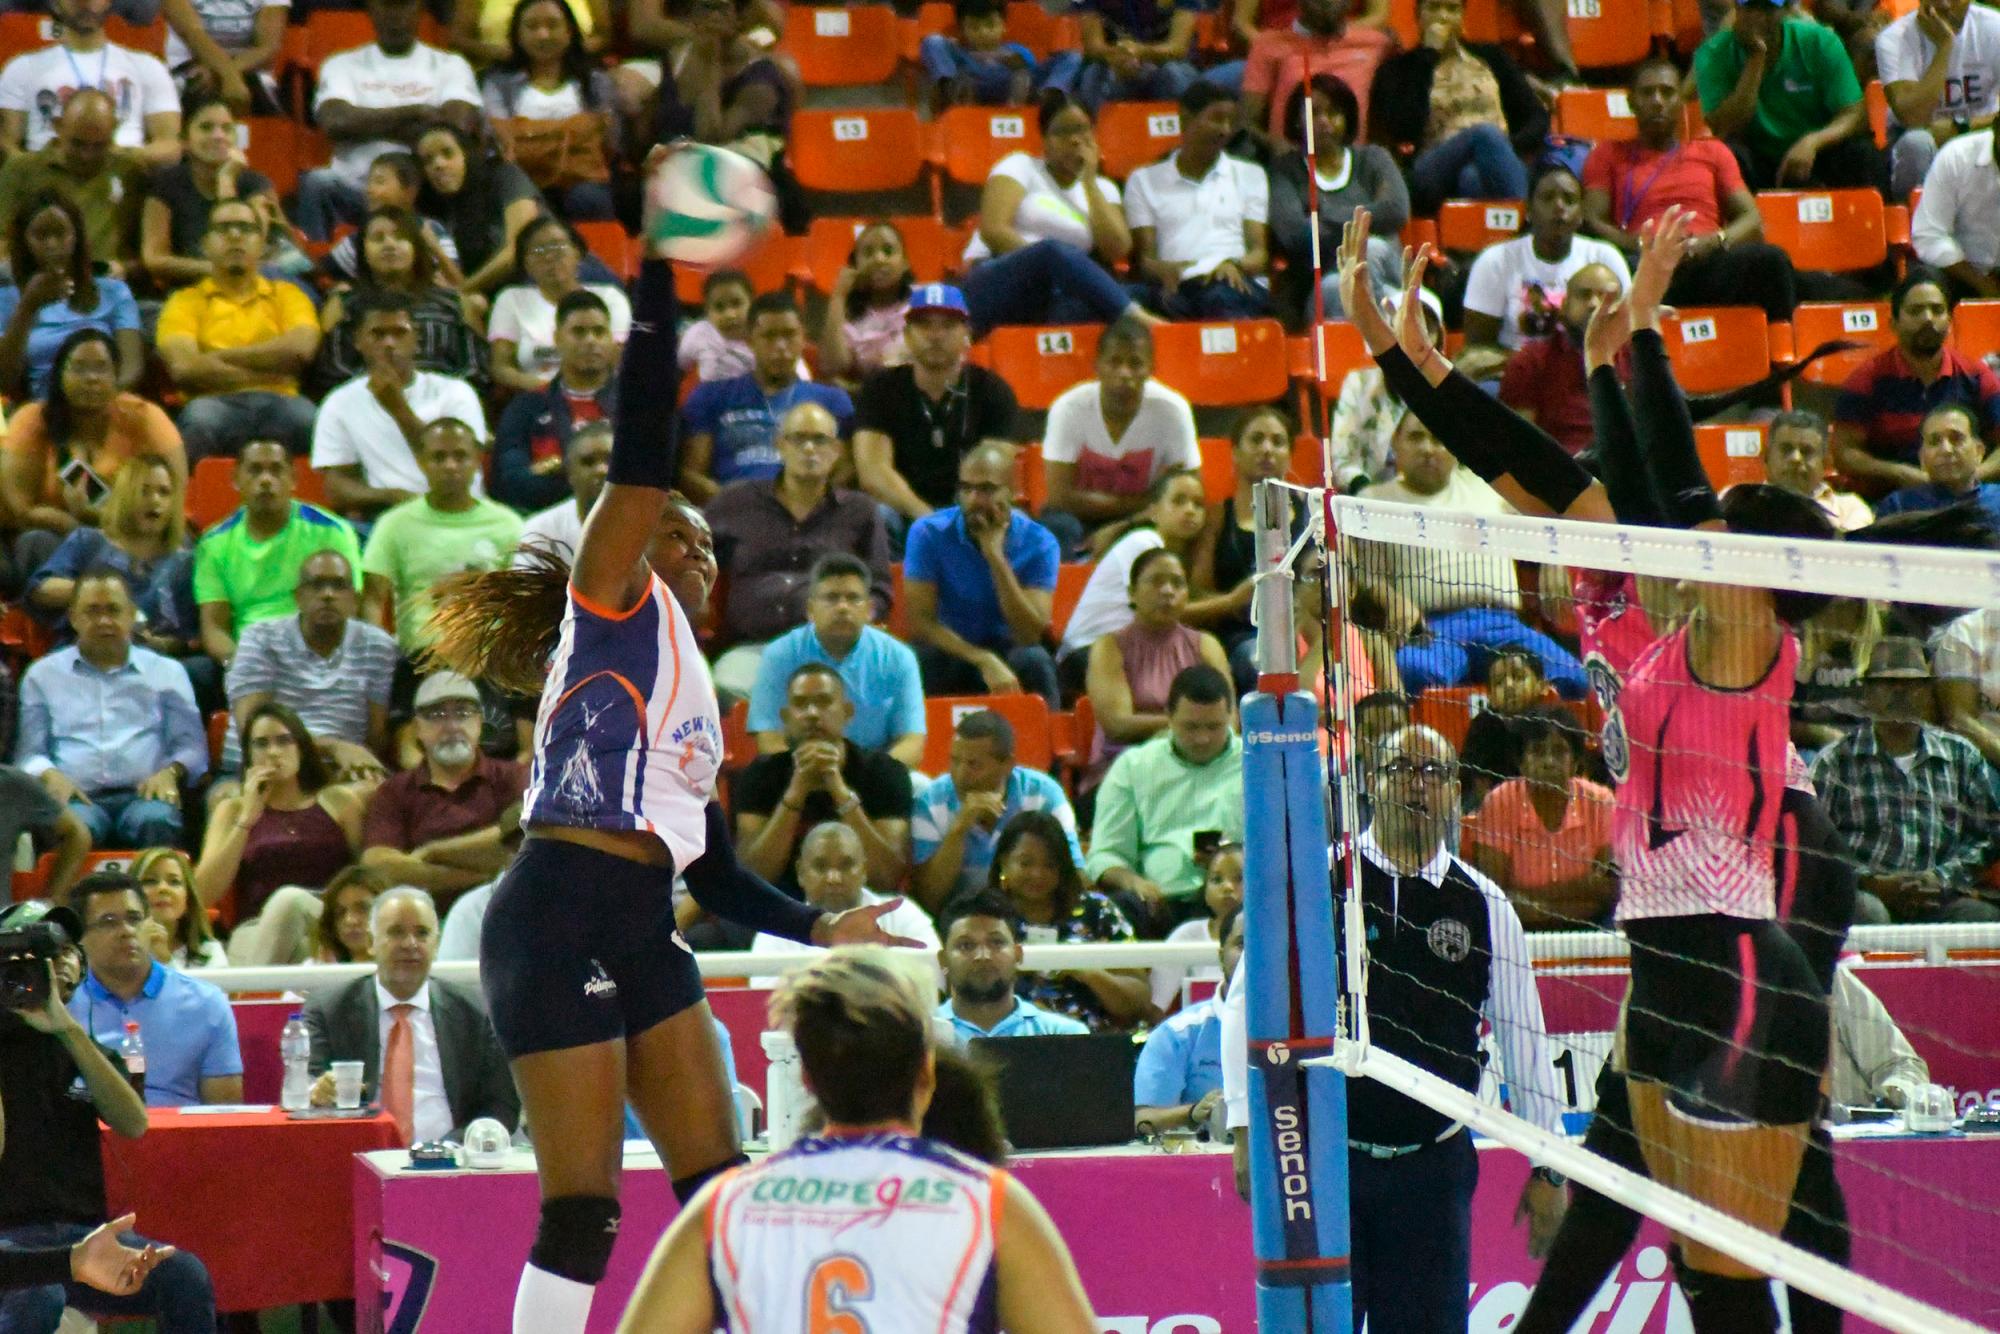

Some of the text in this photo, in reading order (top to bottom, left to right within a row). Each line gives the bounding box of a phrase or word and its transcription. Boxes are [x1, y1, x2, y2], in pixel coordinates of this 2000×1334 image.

[840, 122, 862, 137] 13
[996, 121, 1018, 135] 14
[1155, 118, 1176, 133] 15
[1491, 212, 1513, 227] 17
[1849, 313, 1871, 328] 19
[1688, 323, 1710, 339] 18
[1044, 334, 1070, 353] 14
[672, 715, 704, 744] NEW
[802, 1251, 876, 1334] 6
